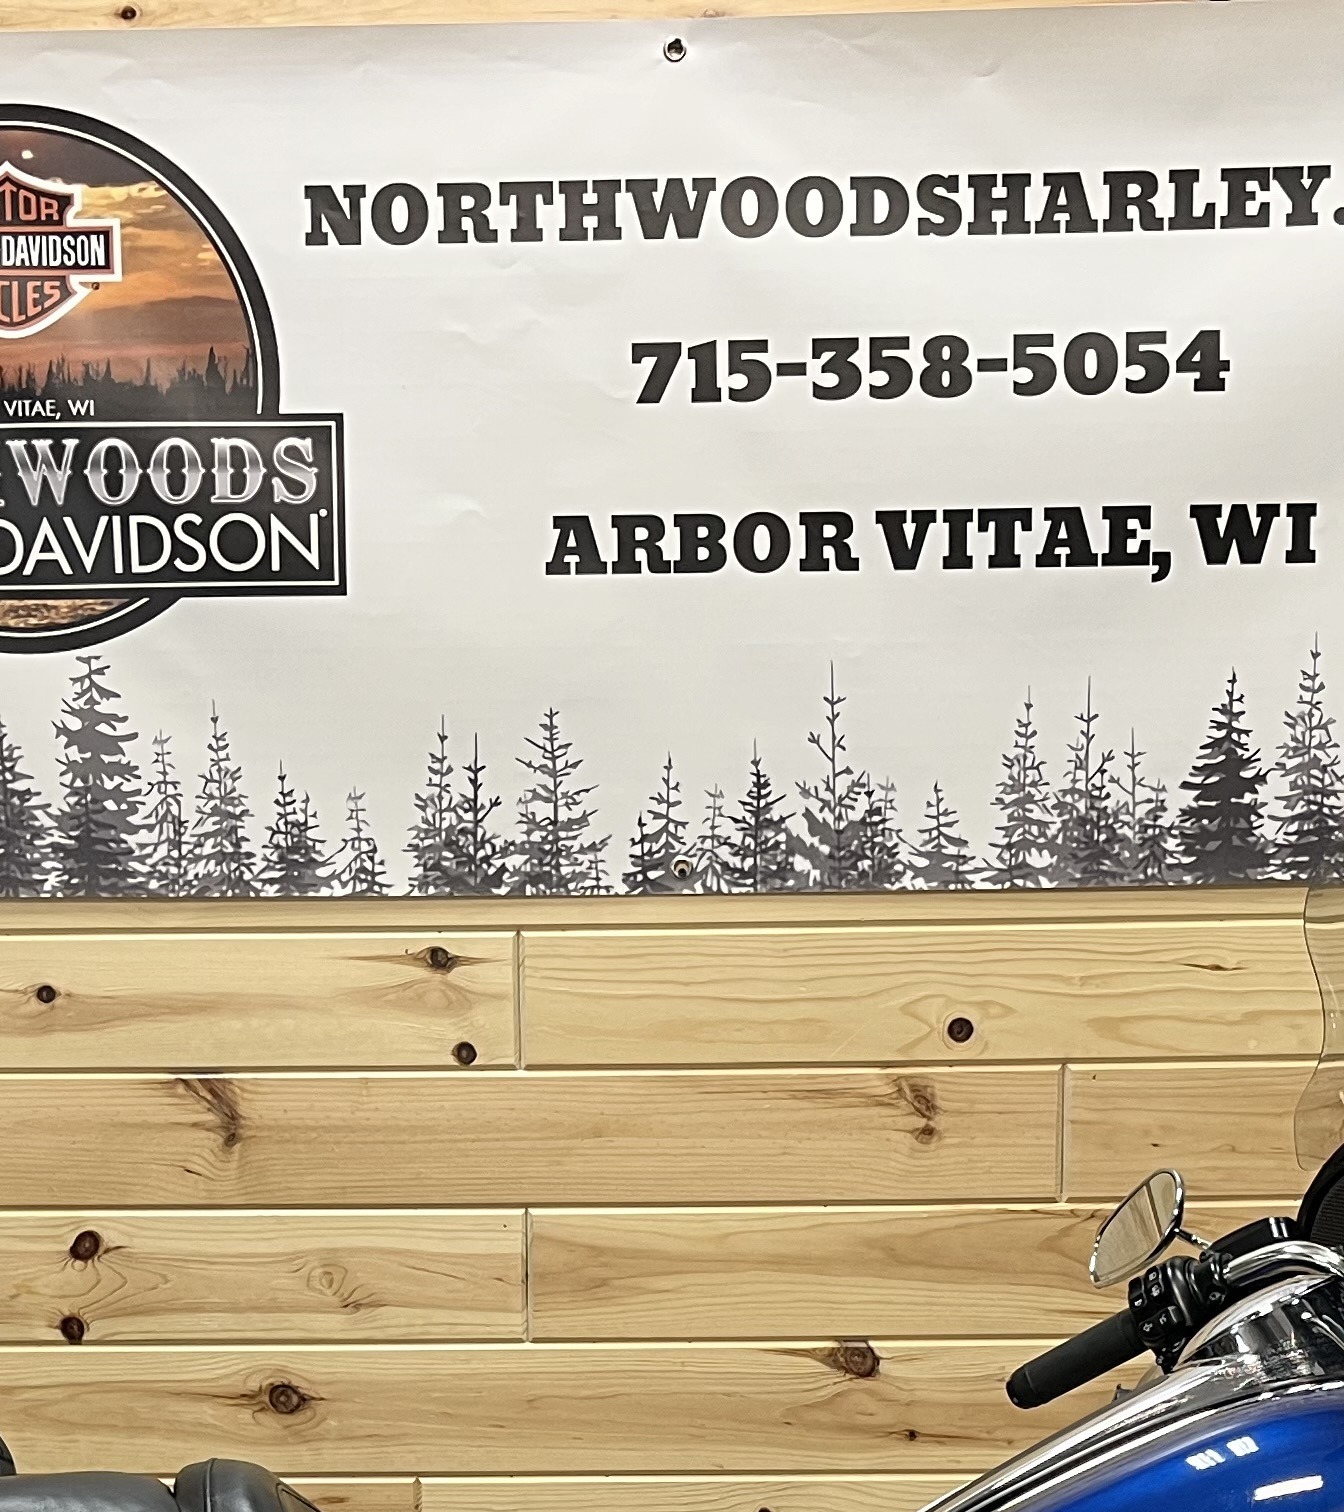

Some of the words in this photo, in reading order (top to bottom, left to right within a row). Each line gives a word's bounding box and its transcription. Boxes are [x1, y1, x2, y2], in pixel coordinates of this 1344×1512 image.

[631, 329, 1231, 404] 715-358-5054
[4, 400, 61, 420] VITAE,
[67, 400, 95, 416] WI
[545, 511, 860, 576] ARBOR
[875, 504, 1172, 583] VITAE,
[1189, 502, 1318, 567] WI
